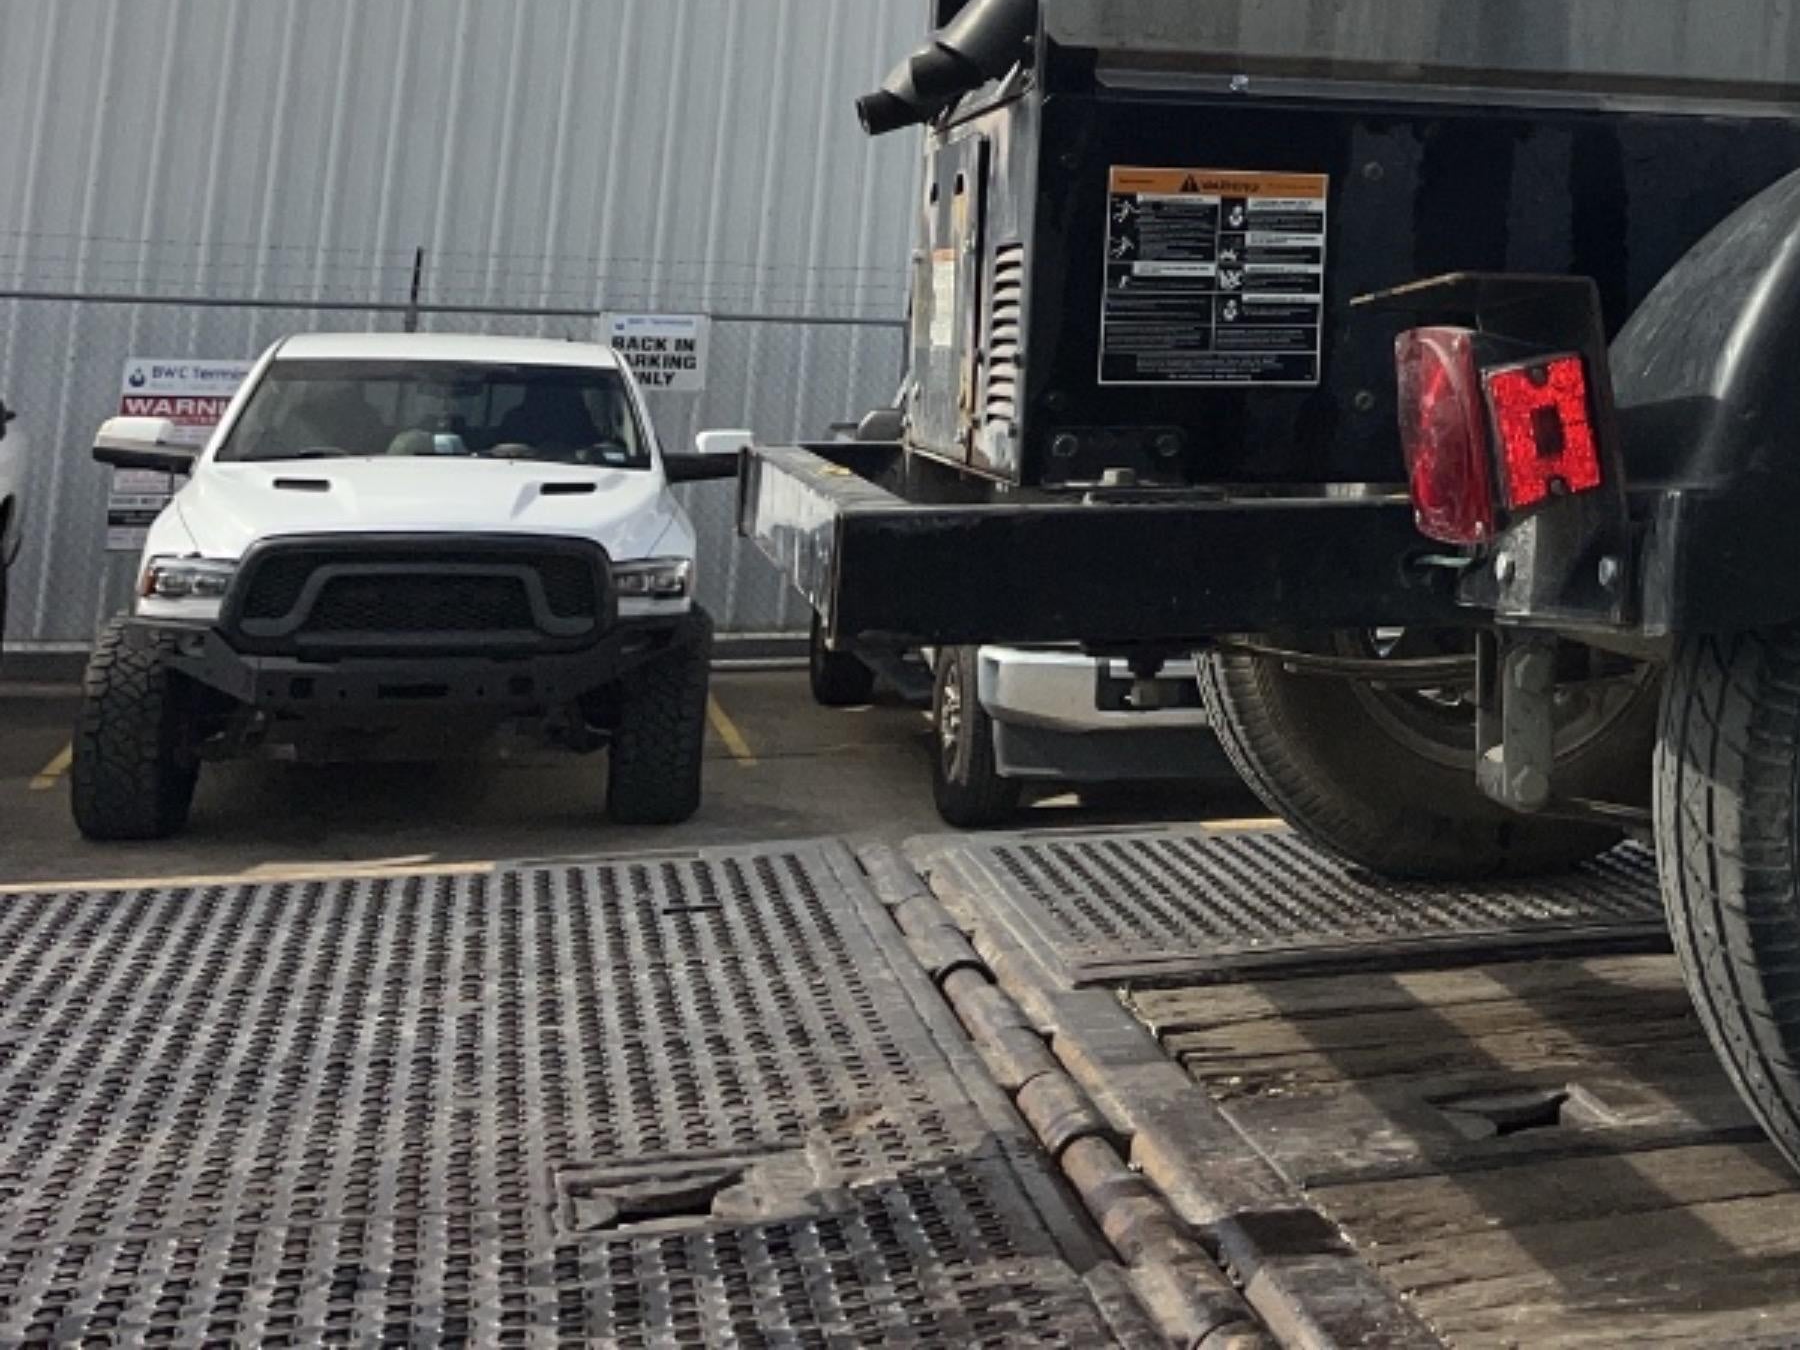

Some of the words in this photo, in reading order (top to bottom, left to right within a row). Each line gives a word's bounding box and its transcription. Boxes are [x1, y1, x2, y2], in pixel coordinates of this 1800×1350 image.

[611, 335, 667, 351] BACK
[622, 352, 697, 370] ARKING
[632, 371, 675, 386] NLY
